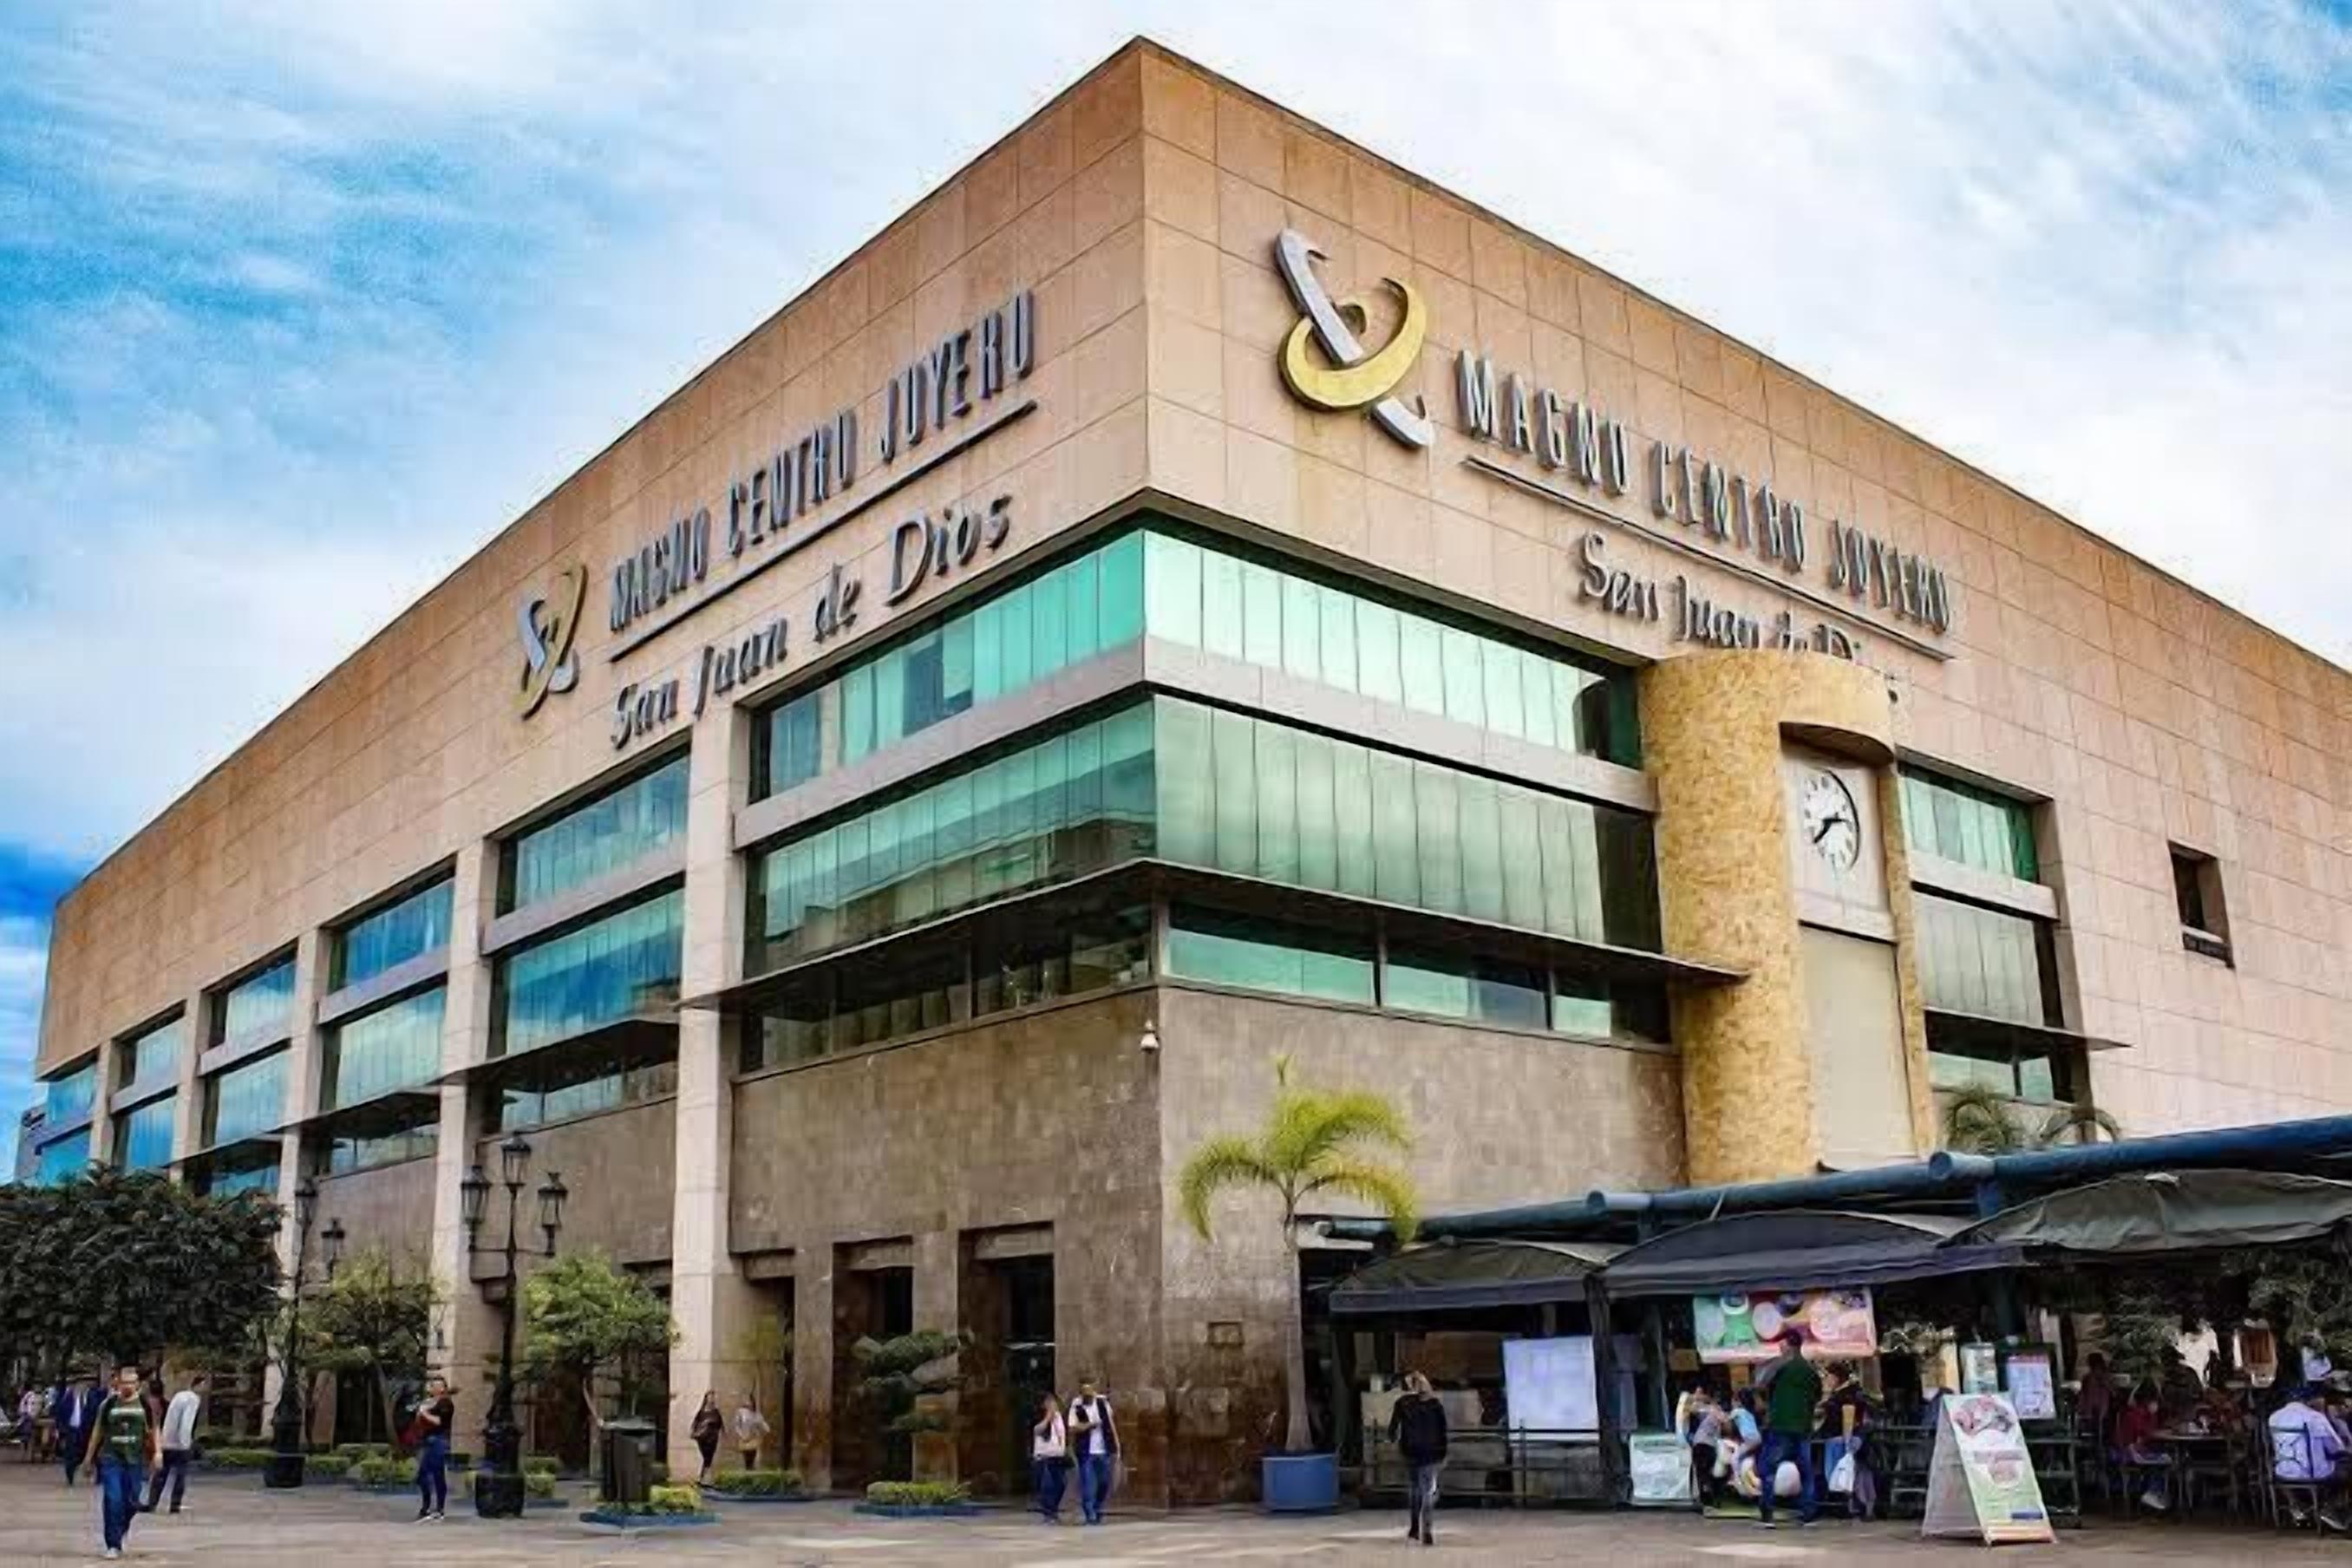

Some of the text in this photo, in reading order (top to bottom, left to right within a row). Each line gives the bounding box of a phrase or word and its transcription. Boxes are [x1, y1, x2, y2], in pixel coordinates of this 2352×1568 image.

[728, 408, 859, 559] CENTRO
[879, 289, 1035, 466] JOYERO
[1454, 349, 1631, 497] MAGNO
[611, 495, 1013, 750] San Juan de Dios
[1579, 527, 1662, 623] San
